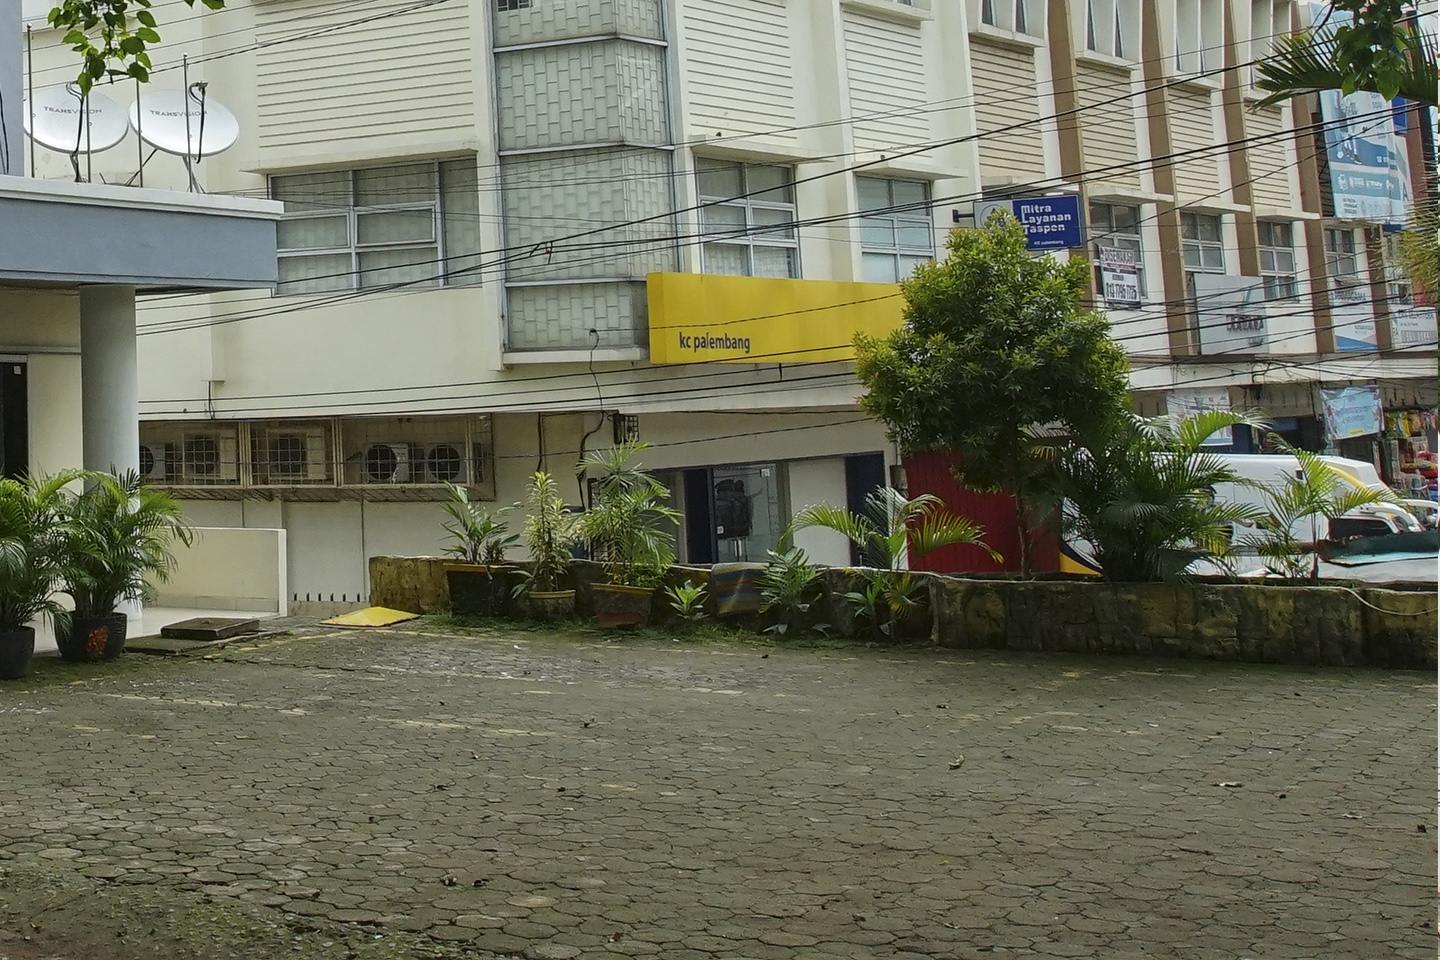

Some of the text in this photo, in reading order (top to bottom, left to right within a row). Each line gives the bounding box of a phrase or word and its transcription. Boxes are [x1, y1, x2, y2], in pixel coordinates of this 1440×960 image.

[44, 105, 103, 115] TRANSVSON
[1020, 204, 1053, 214] Mitra
[1022, 213, 1072, 225] Layanan
[1021, 224, 1066, 235] Taspen
[679, 331, 750, 354] kc palembang
